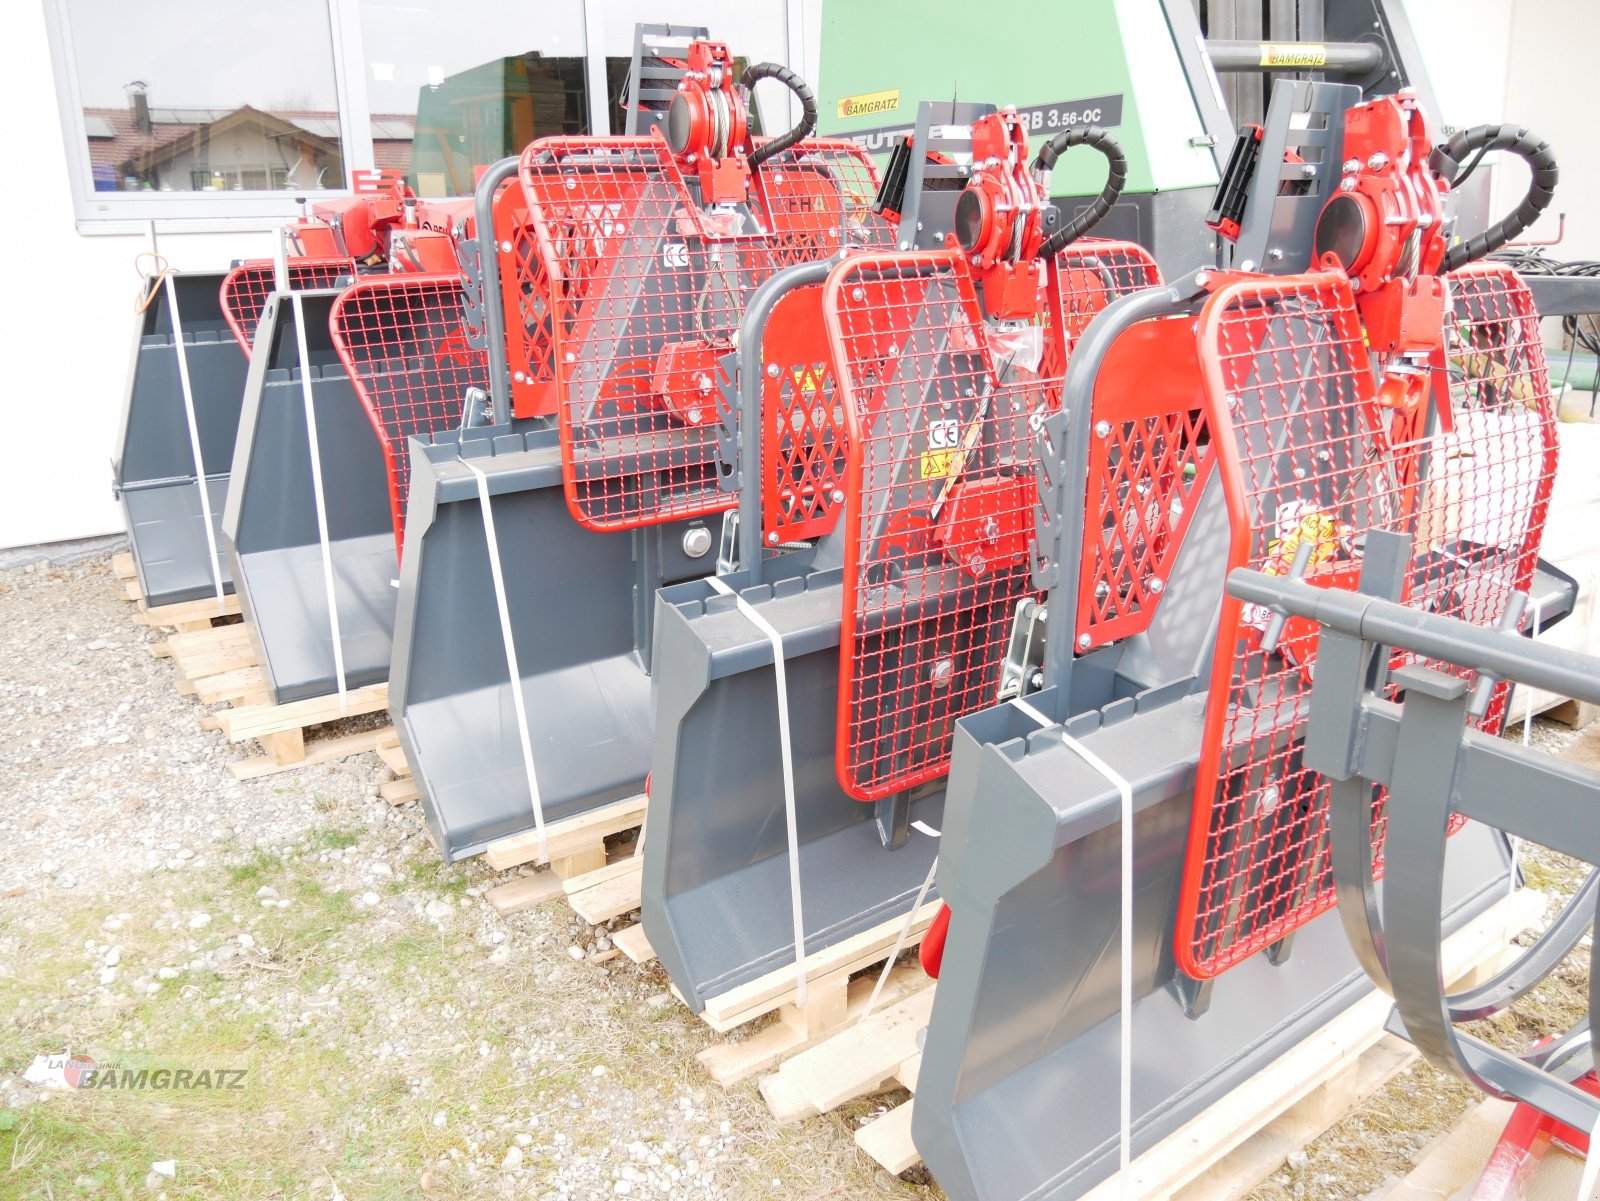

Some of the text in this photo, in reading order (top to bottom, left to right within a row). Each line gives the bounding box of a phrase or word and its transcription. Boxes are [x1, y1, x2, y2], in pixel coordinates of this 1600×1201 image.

[1271, 53, 1324, 65] BAMGRATZ
[846, 97, 898, 116] BAMGRATZ
[1047, 108, 1102, 127] 3.56-OC
